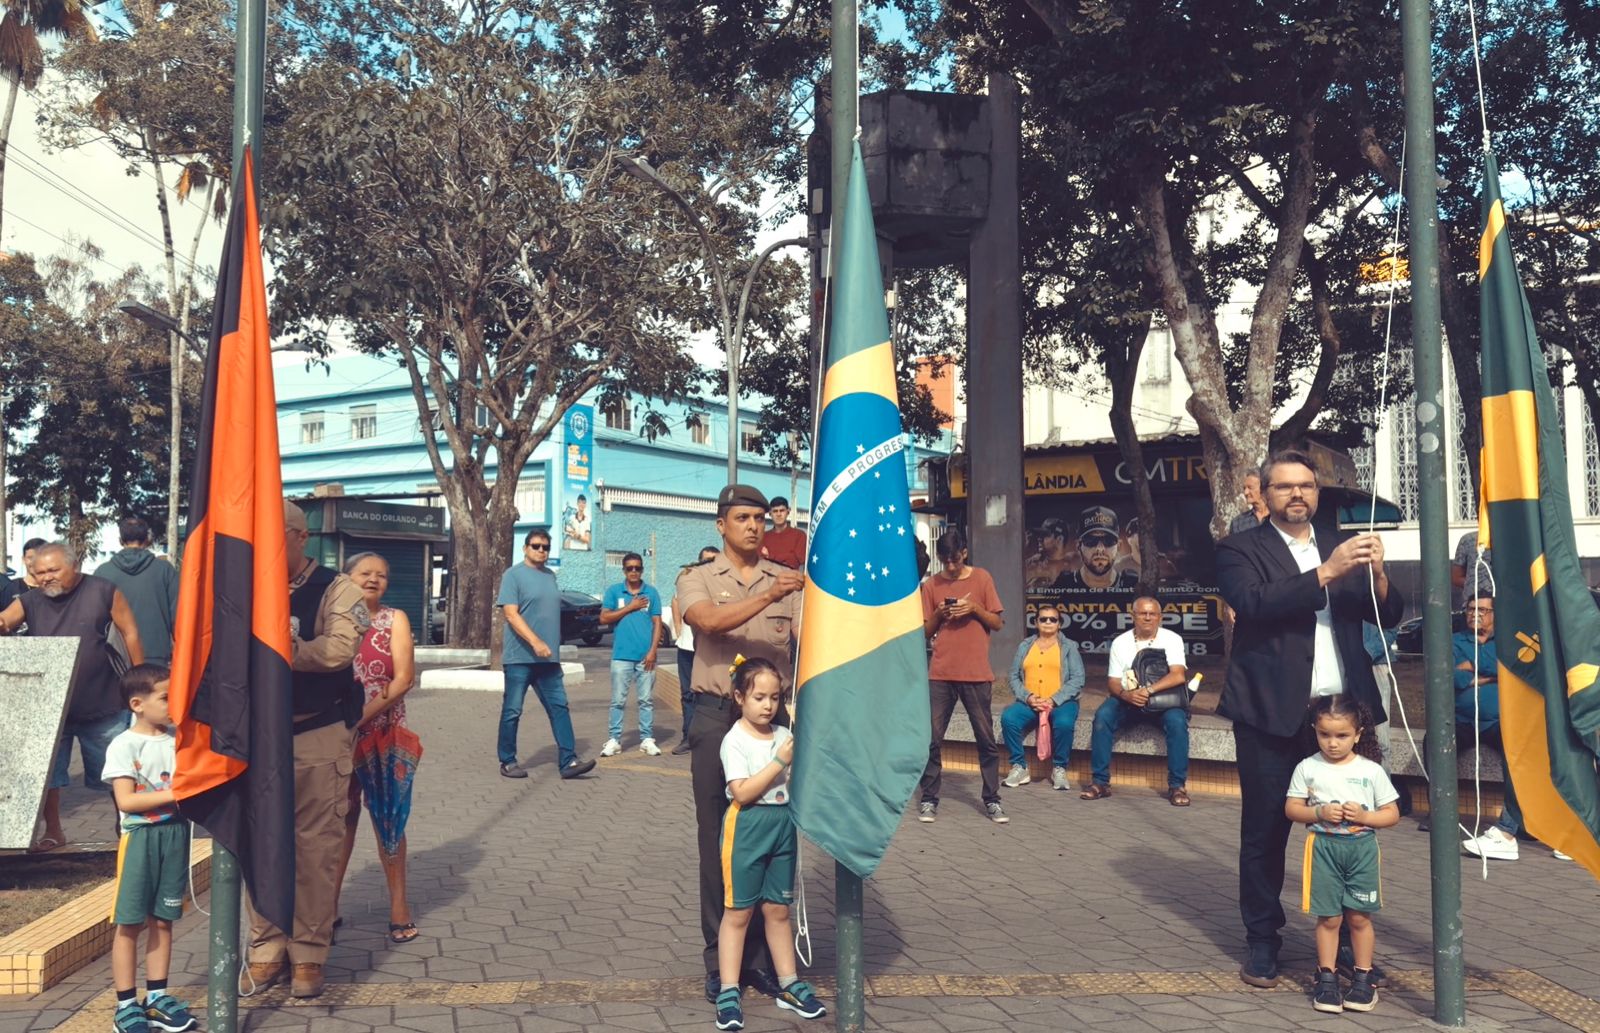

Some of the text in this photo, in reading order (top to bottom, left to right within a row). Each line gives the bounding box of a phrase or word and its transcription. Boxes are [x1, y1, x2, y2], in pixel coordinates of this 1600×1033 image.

[831, 482, 842, 493] E
[342, 511, 368, 520] BANCA
[382, 514, 417, 524] ORLANDO
[1037, 587, 1087, 595] Empresa
[1162, 600, 1207, 613] ATÉ
